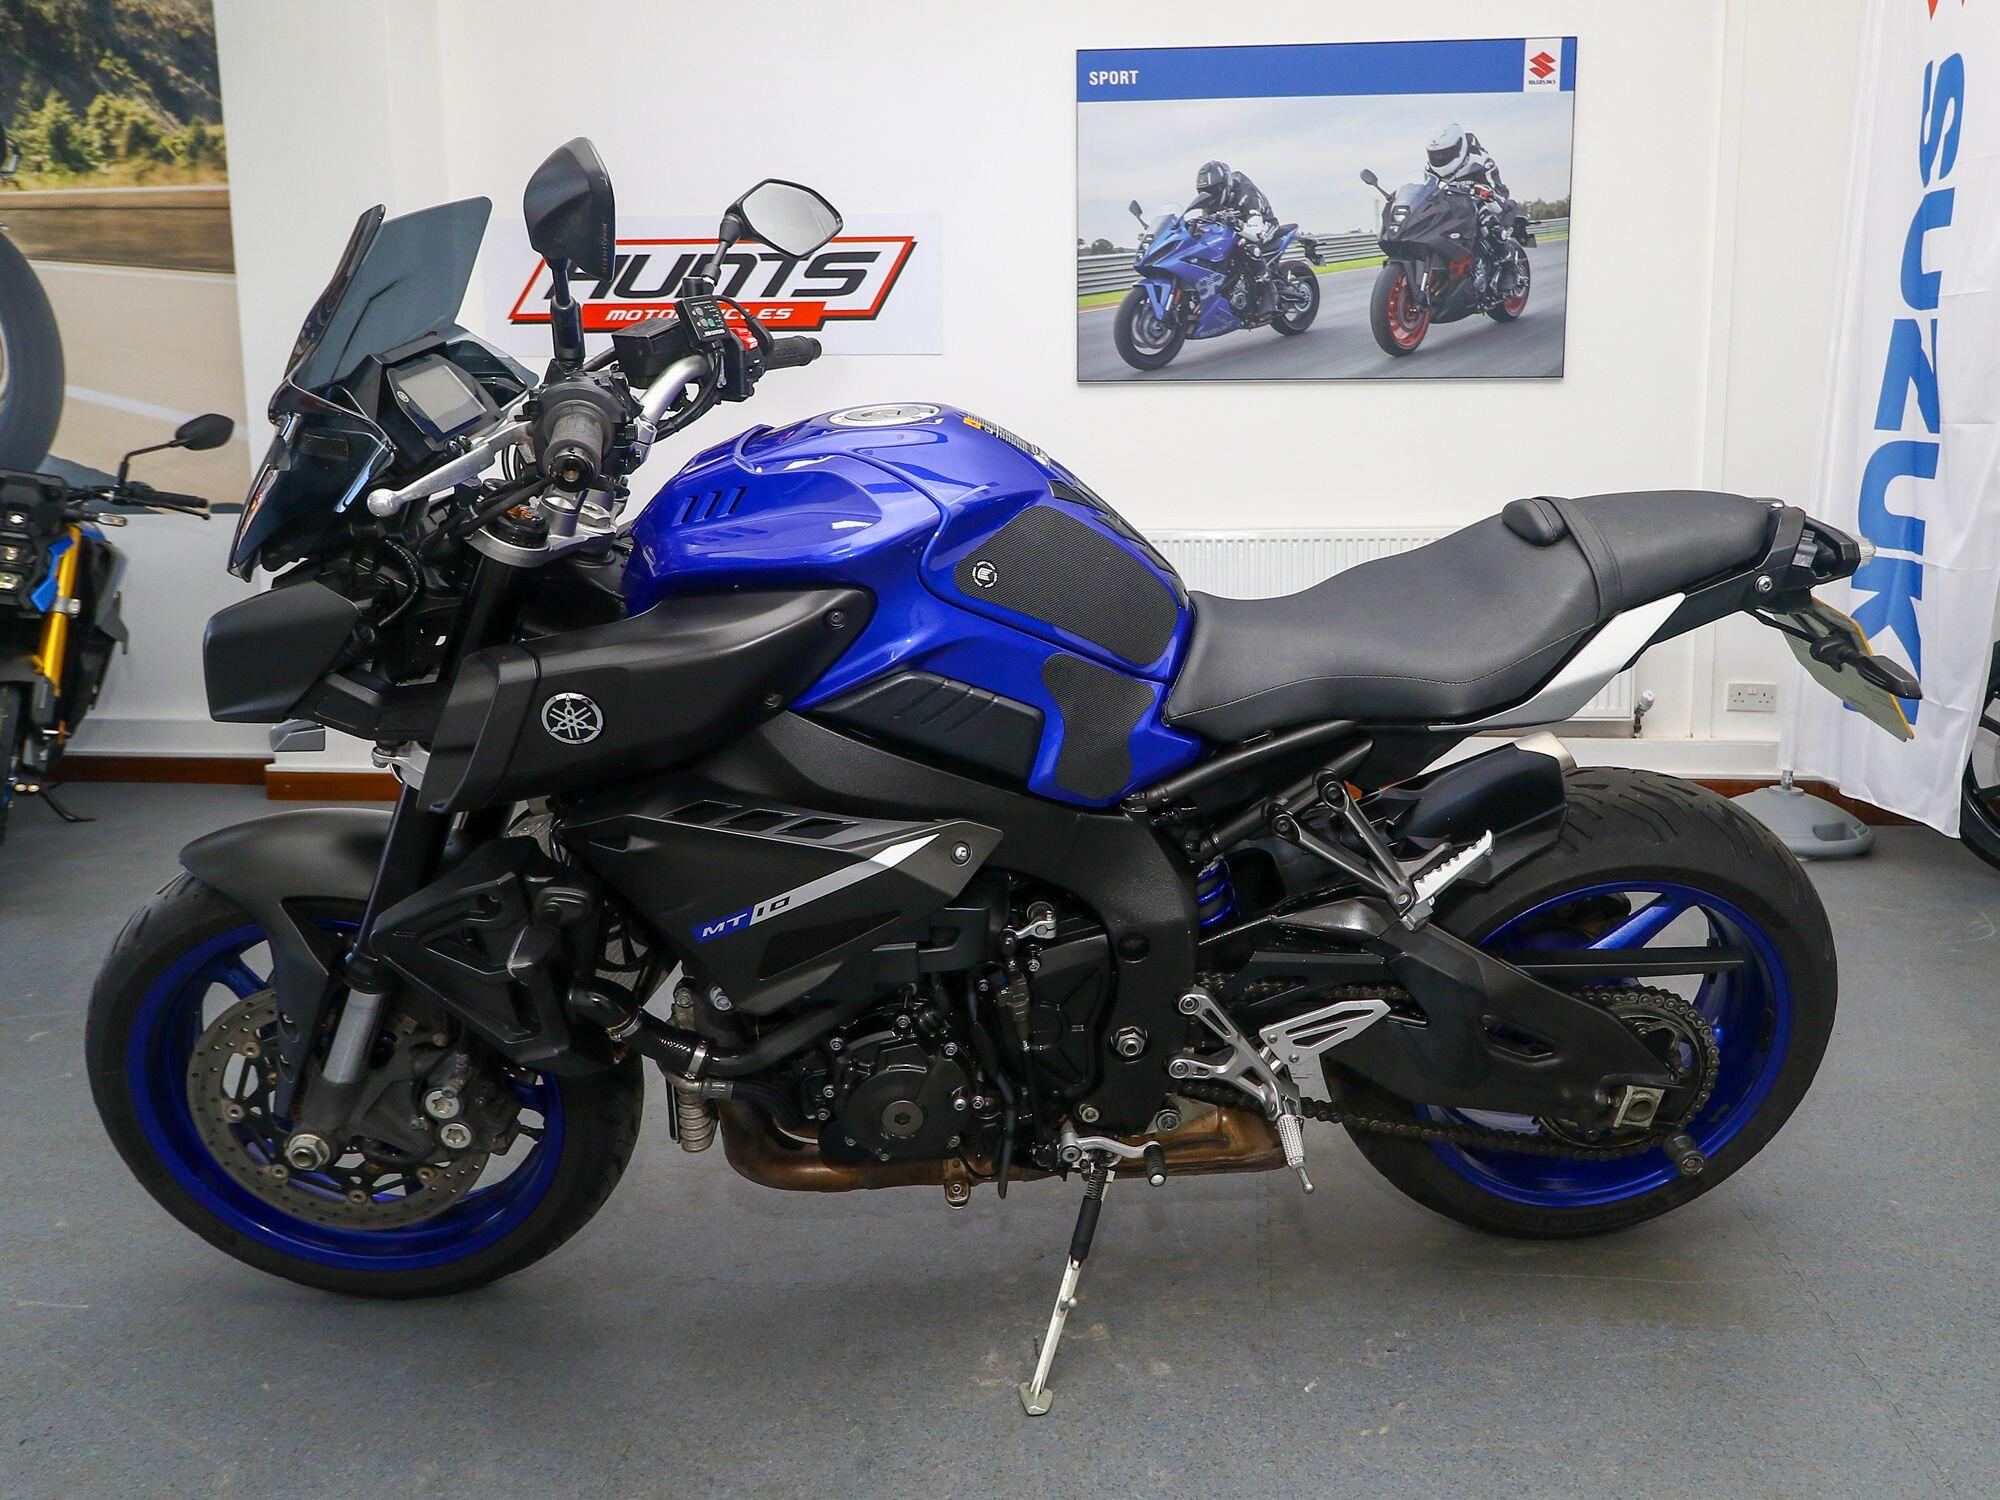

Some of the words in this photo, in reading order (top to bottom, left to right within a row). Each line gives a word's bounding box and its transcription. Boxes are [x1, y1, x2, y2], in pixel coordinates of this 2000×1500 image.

[1088, 70, 1139, 85] SPORT
[1842, 52, 1965, 726] SUZUK
[702, 913, 748, 937] MT
[756, 896, 790, 917] 10
